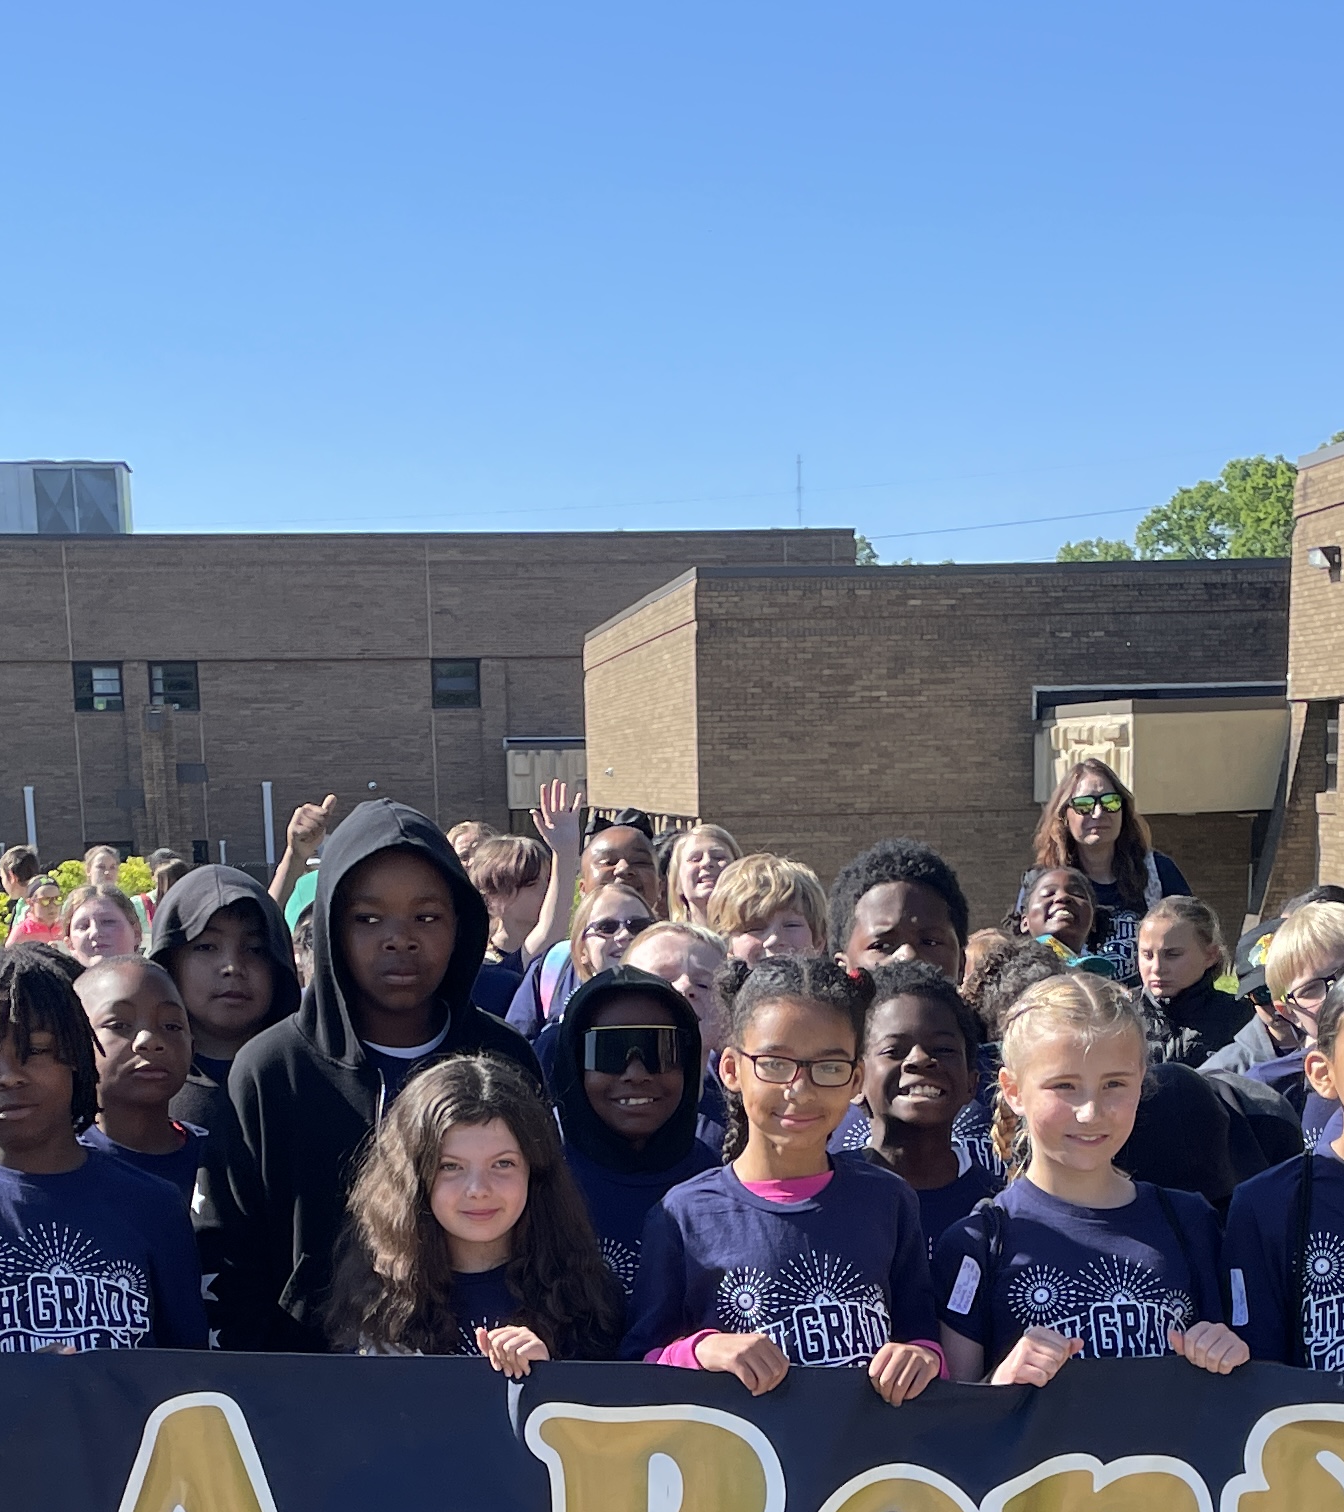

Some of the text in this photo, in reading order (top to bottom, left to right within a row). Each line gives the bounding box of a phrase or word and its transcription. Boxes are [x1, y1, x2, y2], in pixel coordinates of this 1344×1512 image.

[27, 1272, 150, 1333] GRADE
[792, 1301, 891, 1365] GRAD
[1089, 1301, 1186, 1359] GRA
